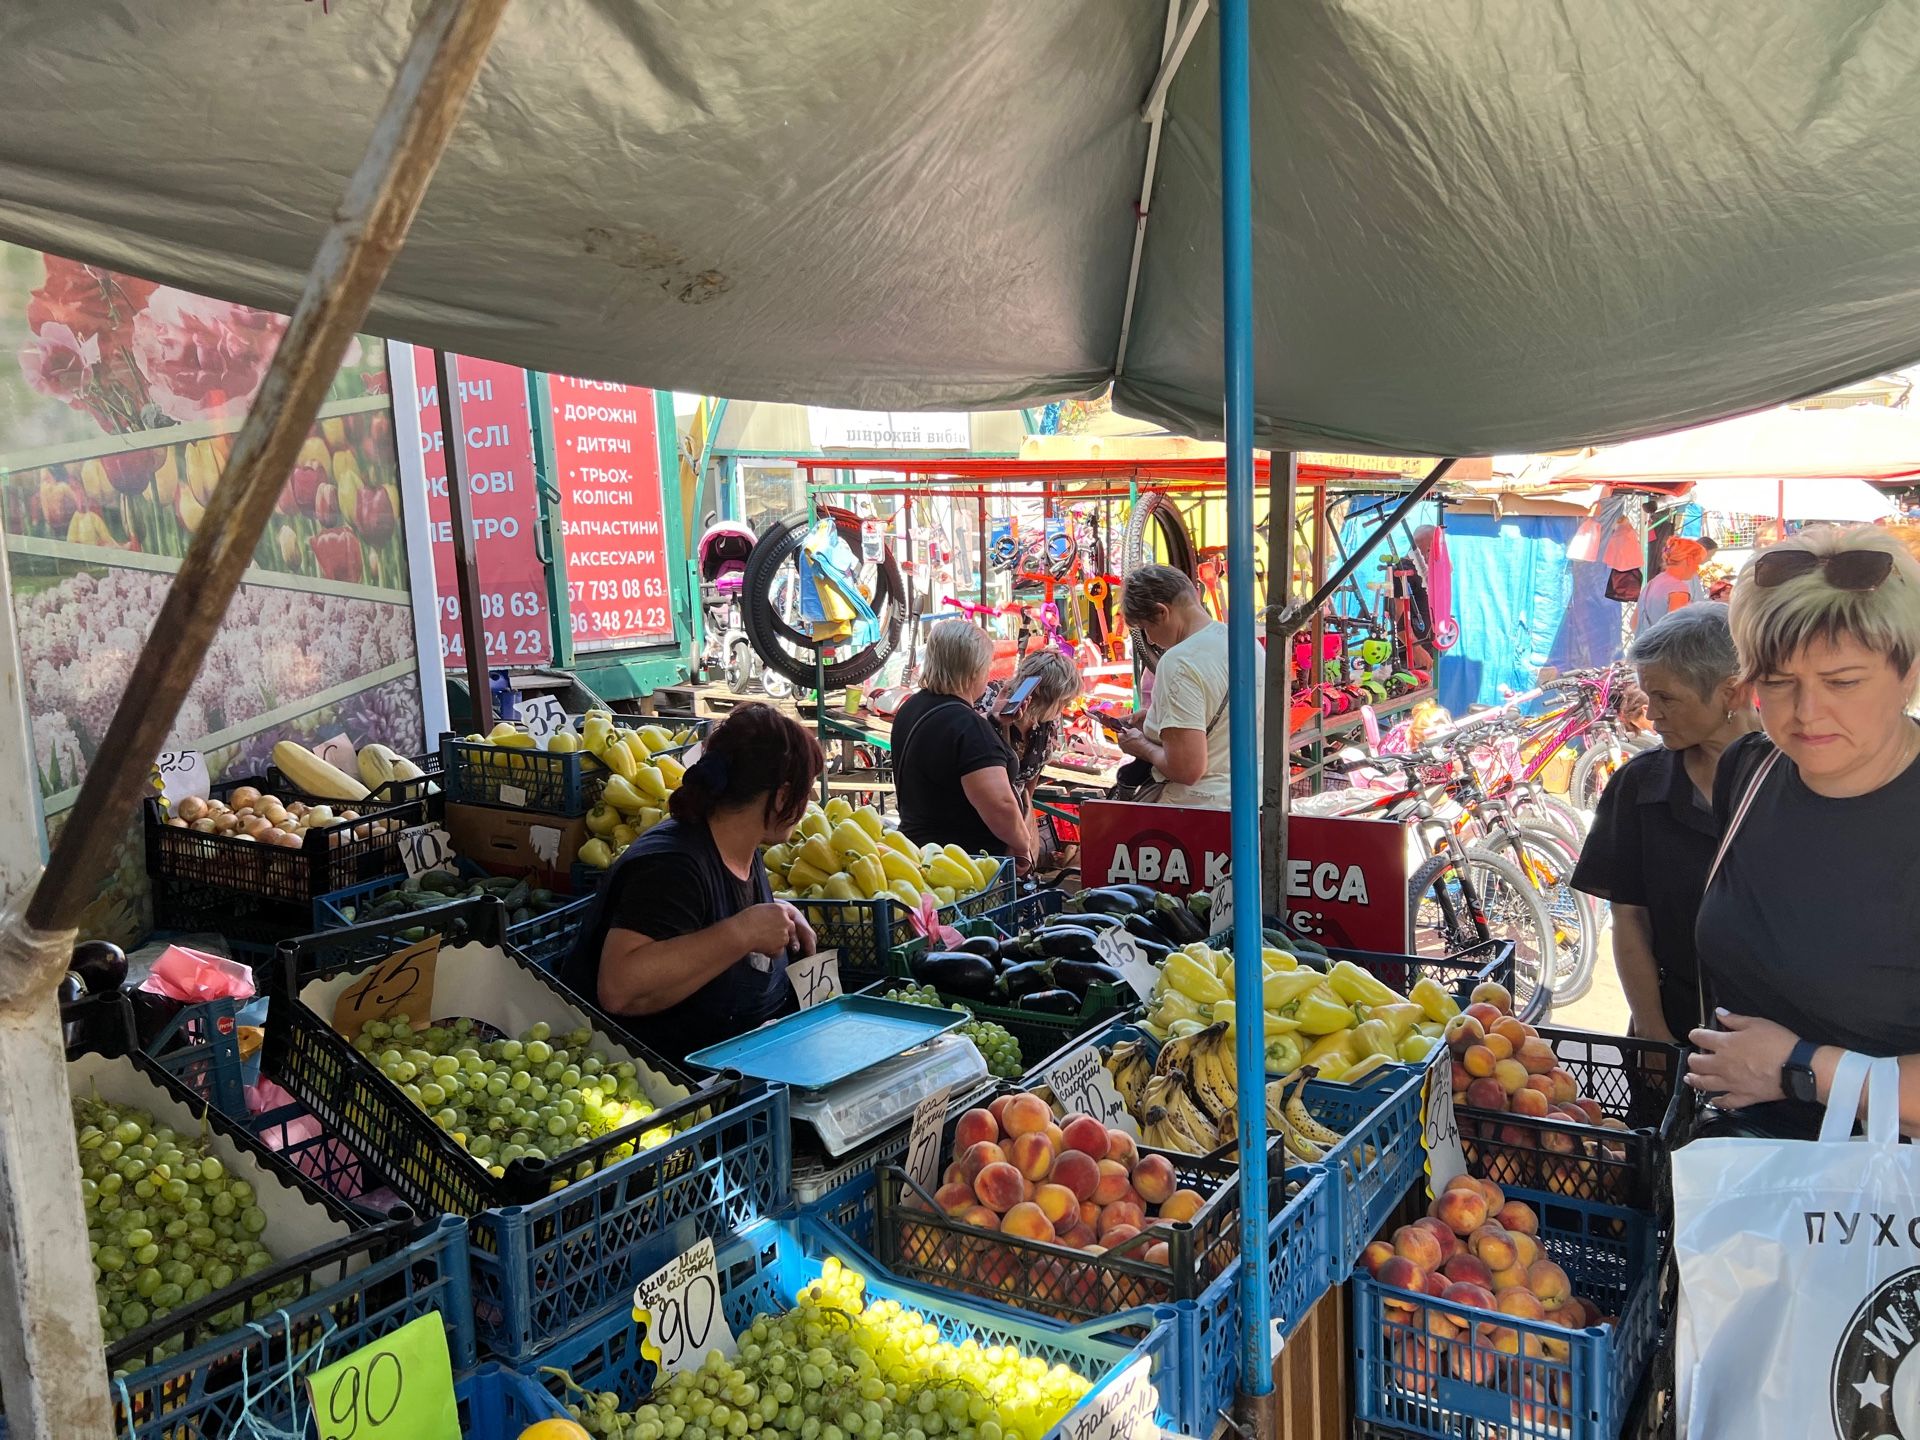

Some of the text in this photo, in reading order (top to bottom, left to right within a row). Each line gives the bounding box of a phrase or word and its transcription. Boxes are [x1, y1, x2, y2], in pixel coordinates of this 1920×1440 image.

[418, 379, 493, 412] ИЯЧІ
[564, 403, 637, 424] ДОРОЖНІ
[419, 424, 510, 454] ОРСЛІ
[576, 436, 631, 454] ДИТЯЧІ
[424, 470, 515, 498] ЮОВІ
[580, 467, 633, 484] ТРЬОХ-
[572, 489, 633, 505] КОЛІСНІ
[561, 520, 660, 536] ЗАПЧАСТИНИ
[569, 550, 656, 567] АКСЕСУАРИ
[588, 579, 619, 600] 793
[621, 578, 641, 598] 08
[643, 577, 662, 597] 63
[437, 591, 540, 620] 79 08 63
[591, 609, 621, 632] 348
[623, 608, 644, 629] 24
[646, 607, 666, 628] 23
[440, 629, 543, 658] 34 24 23
[525, 699, 567, 737] 35
[160, 750, 196, 773] 25
[404, 832, 442, 875] 10
[1107, 842, 1369, 905] ДВА КЕСА
[1100, 924, 1136, 969] 35
[344, 946, 437, 1012] 75
[798, 957, 837, 1007] 75
[658, 1274, 716, 1366] 90
[325, 1351, 403, 1440] 90
